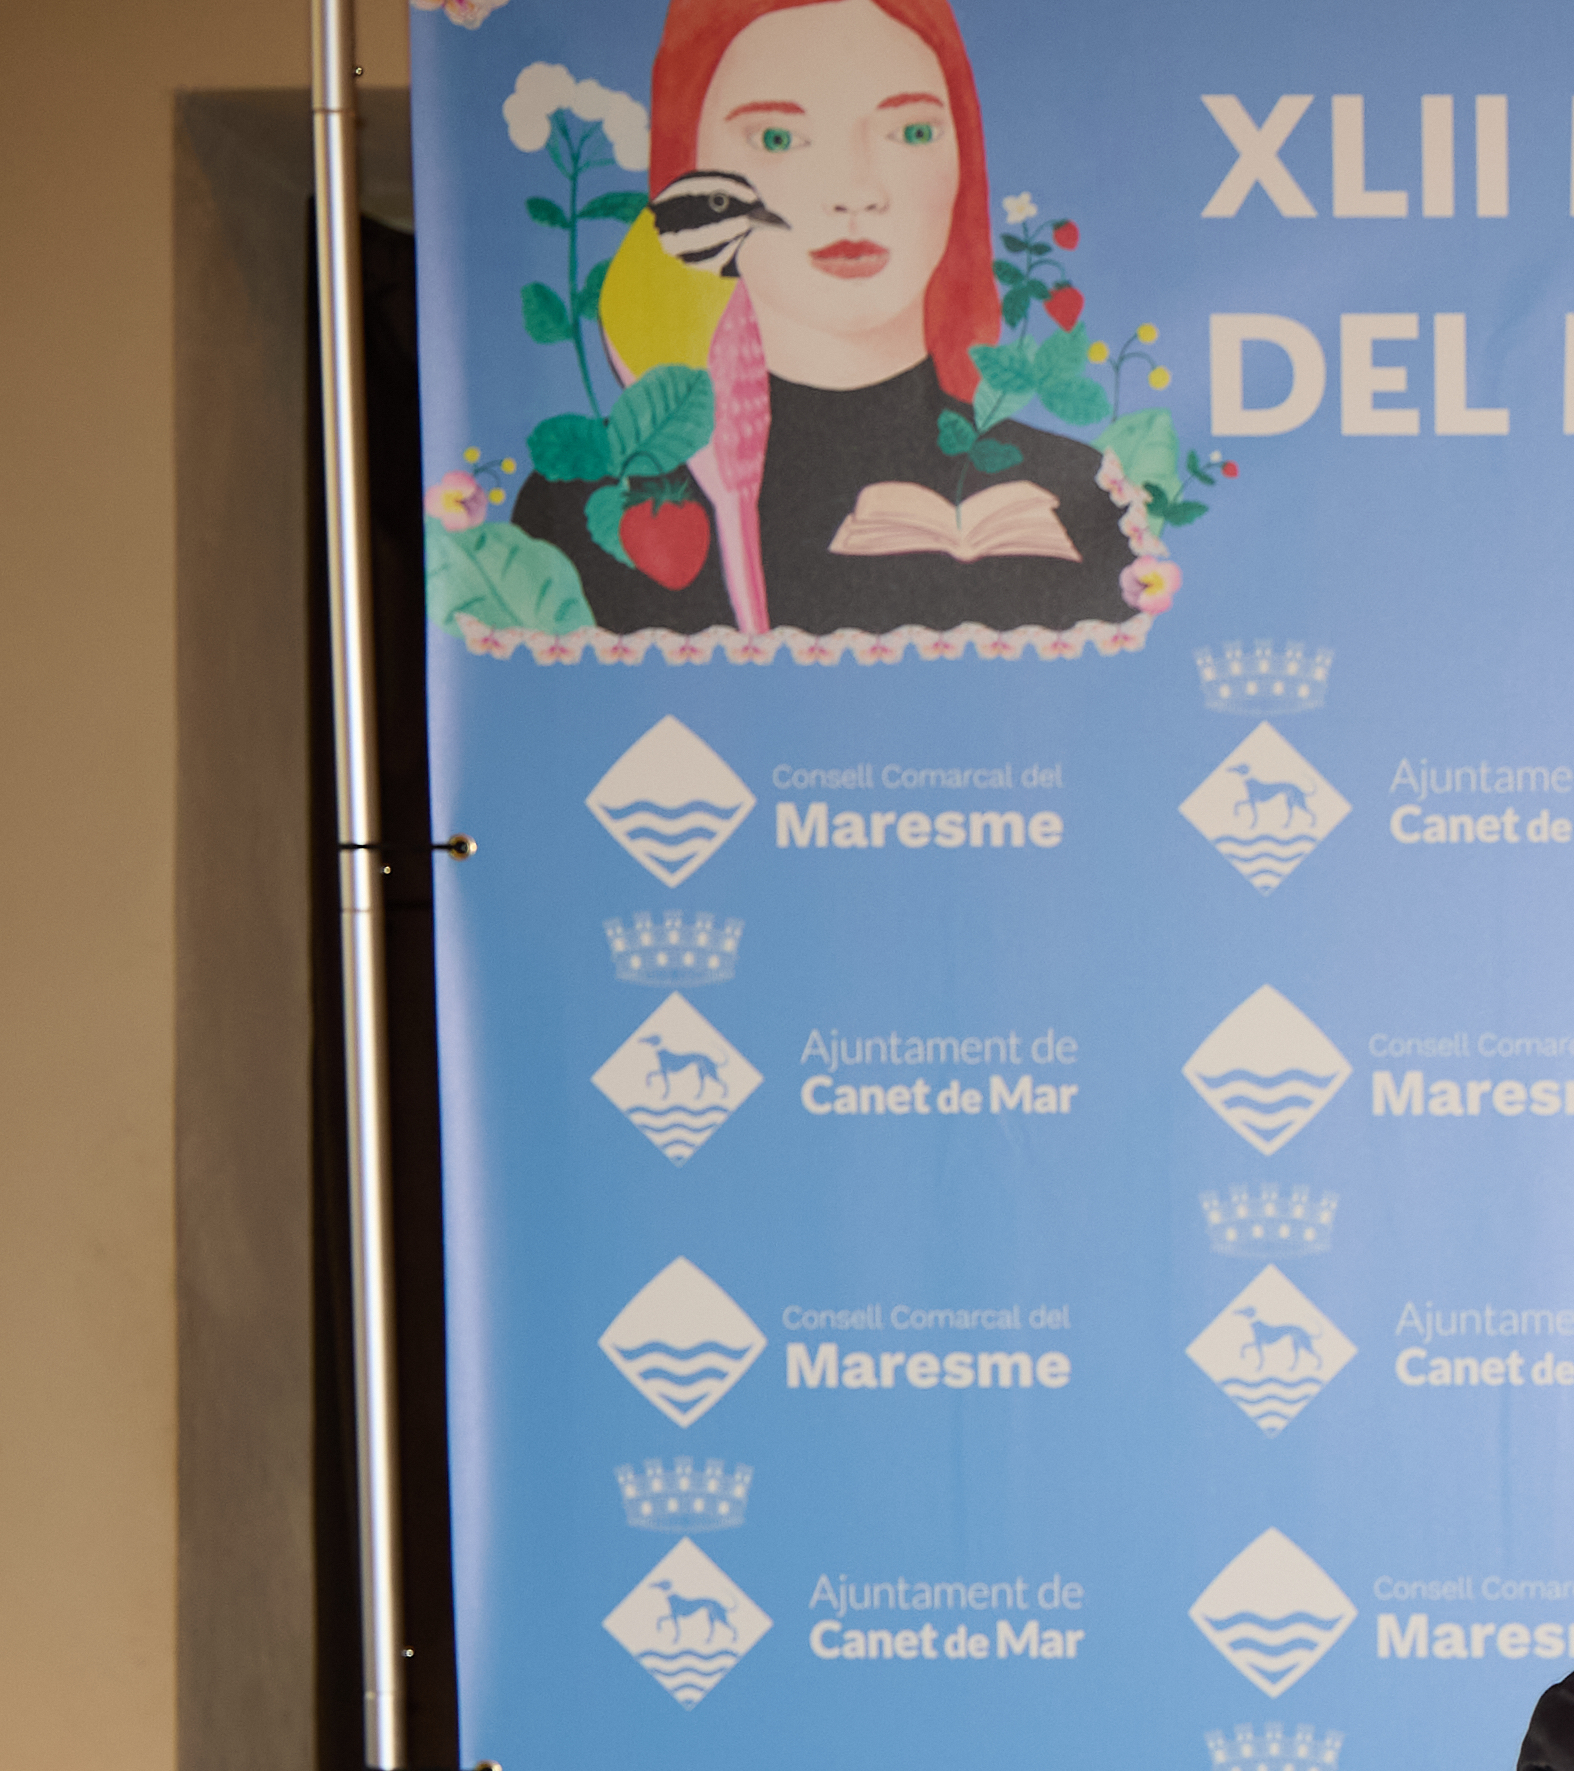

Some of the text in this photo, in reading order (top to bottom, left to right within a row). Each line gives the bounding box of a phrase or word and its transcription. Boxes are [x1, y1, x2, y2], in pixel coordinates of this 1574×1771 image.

[1202, 95, 1508, 217] XLII
[1211, 314, 1509, 435] DEL
[772, 764, 1062, 789] Consell Comarcal del
[777, 802, 1063, 847] Maresme
[1390, 805, 1519, 843] Canet
[1527, 810, 1572, 842] de
[782, 1304, 1070, 1330] Consell Comarcal del
[787, 1343, 1070, 1388] Maresme
